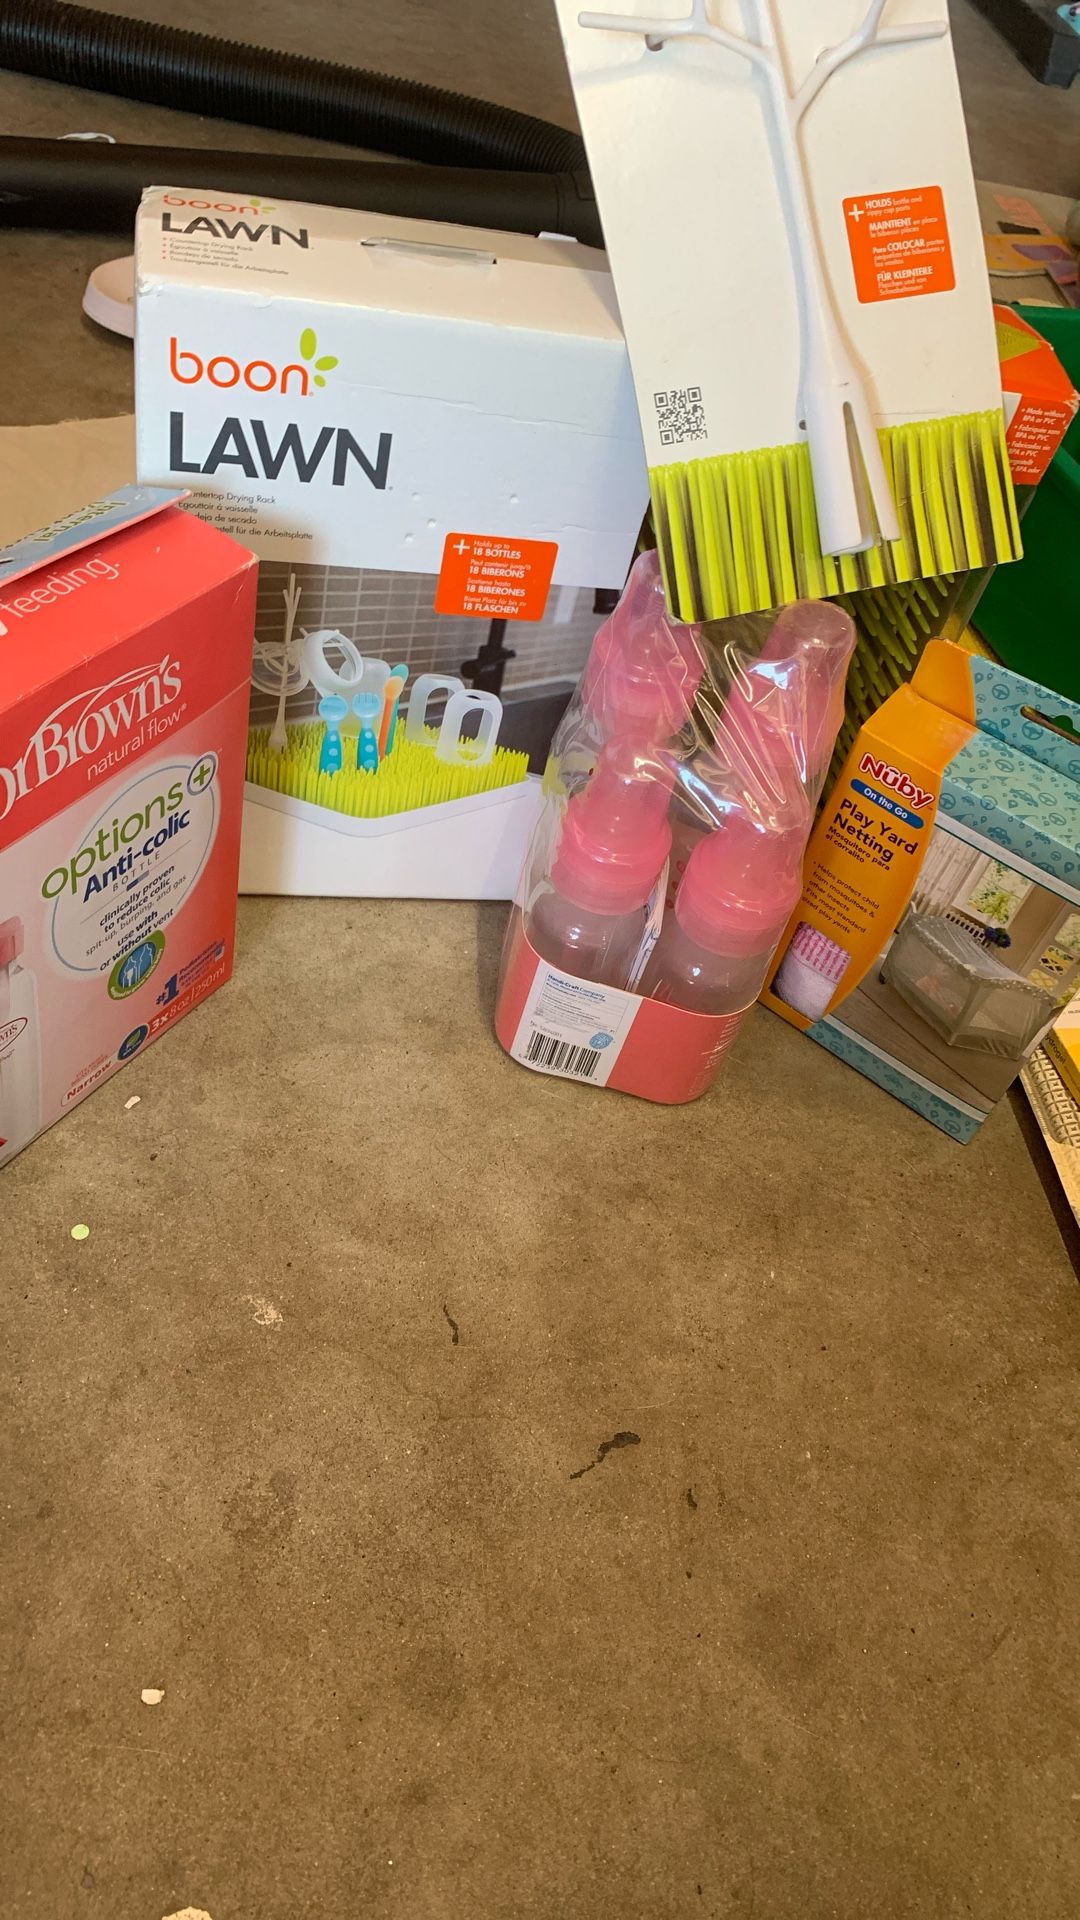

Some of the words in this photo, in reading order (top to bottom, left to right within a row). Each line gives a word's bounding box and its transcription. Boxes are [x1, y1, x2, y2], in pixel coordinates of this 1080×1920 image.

[163, 194, 259, 216] boon
[865, 197, 892, 209] HOLDS
[162, 212, 310, 249] LAWN
[869, 217, 912, 231] MAINTIENT
[887, 238, 925, 252] COLOCAR
[876, 270, 892, 281] FÜR
[893, 265, 933, 280] KLEINTEILE
[170, 336, 309, 396] boon
[169, 411, 394, 490] LAWN
[226, 492, 254, 504] Drying
[256, 494, 277, 504] Rack
[214, 514, 226, 523] de
[227, 516, 258, 525] secado
[236, 525, 247, 535] für
[248, 528, 262, 536] die
[473, 540, 493, 549] Holds
[473, 547, 484, 556] 18
[485, 548, 522, 560] BOTTLES
[469, 565, 479, 575] 18
[481, 566, 525, 579] BIBERONS
[466, 584, 476, 593] 18
[478, 585, 526, 597] BIBERONES
[463, 601, 473, 611] 18
[474, 602, 519, 615] FLASCHEN
[87, 726, 145, 781] natural
[147, 708, 180, 740] flow
[863, 787, 876, 800] On
[878, 793, 894, 810] the
[893, 807, 908, 820] Go
[41, 781, 183, 899] options
[833, 813, 895, 862] Netting
[839, 798, 875, 829] Play
[879, 821, 919, 855] Yard
[83, 809, 190, 903] Anti-colic
[825, 834, 833, 842] el
[833, 839, 865, 863] corralito
[828, 826, 872, 858] Mosquitero
[871, 856, 891, 871] para
[112, 852, 160, 893] BOTTLE
[817, 863, 837, 880] Helps
[837, 877, 861, 899] protect
[861, 893, 880, 910] child
[100, 888, 141, 927] clinically
[142, 865, 175, 898] proven
[104, 919, 116, 933] to
[117, 893, 149, 926] reduce
[149, 877, 171, 900] colic
[805, 887, 819, 900] Fits
[818, 899, 837, 916] most
[836, 908, 867, 935] standard
[808, 879, 826, 894] other
[826, 891, 850, 913] insects
[812, 871, 829, 886] from
[829, 880, 869, 914] mosquitoes
[868, 909, 876, 919] &
[85, 929, 118, 957] spit-up,
[155, 886, 172, 904] and
[172, 874, 187, 890] gas
[117, 928, 134, 947] use
[135, 910, 158, 931] with
[818, 907, 833, 921] play
[832, 919, 851, 935] yards
[100, 959, 111, 971] or
[111, 928, 152, 965] without
[152, 908, 174, 928] vent
[155, 973, 180, 1006] #1
[579, 986, 606, 1000] Company
[1043, 1033, 1067, 1065] ydrogel
[66, 1059, 112, 1100] Narrow
